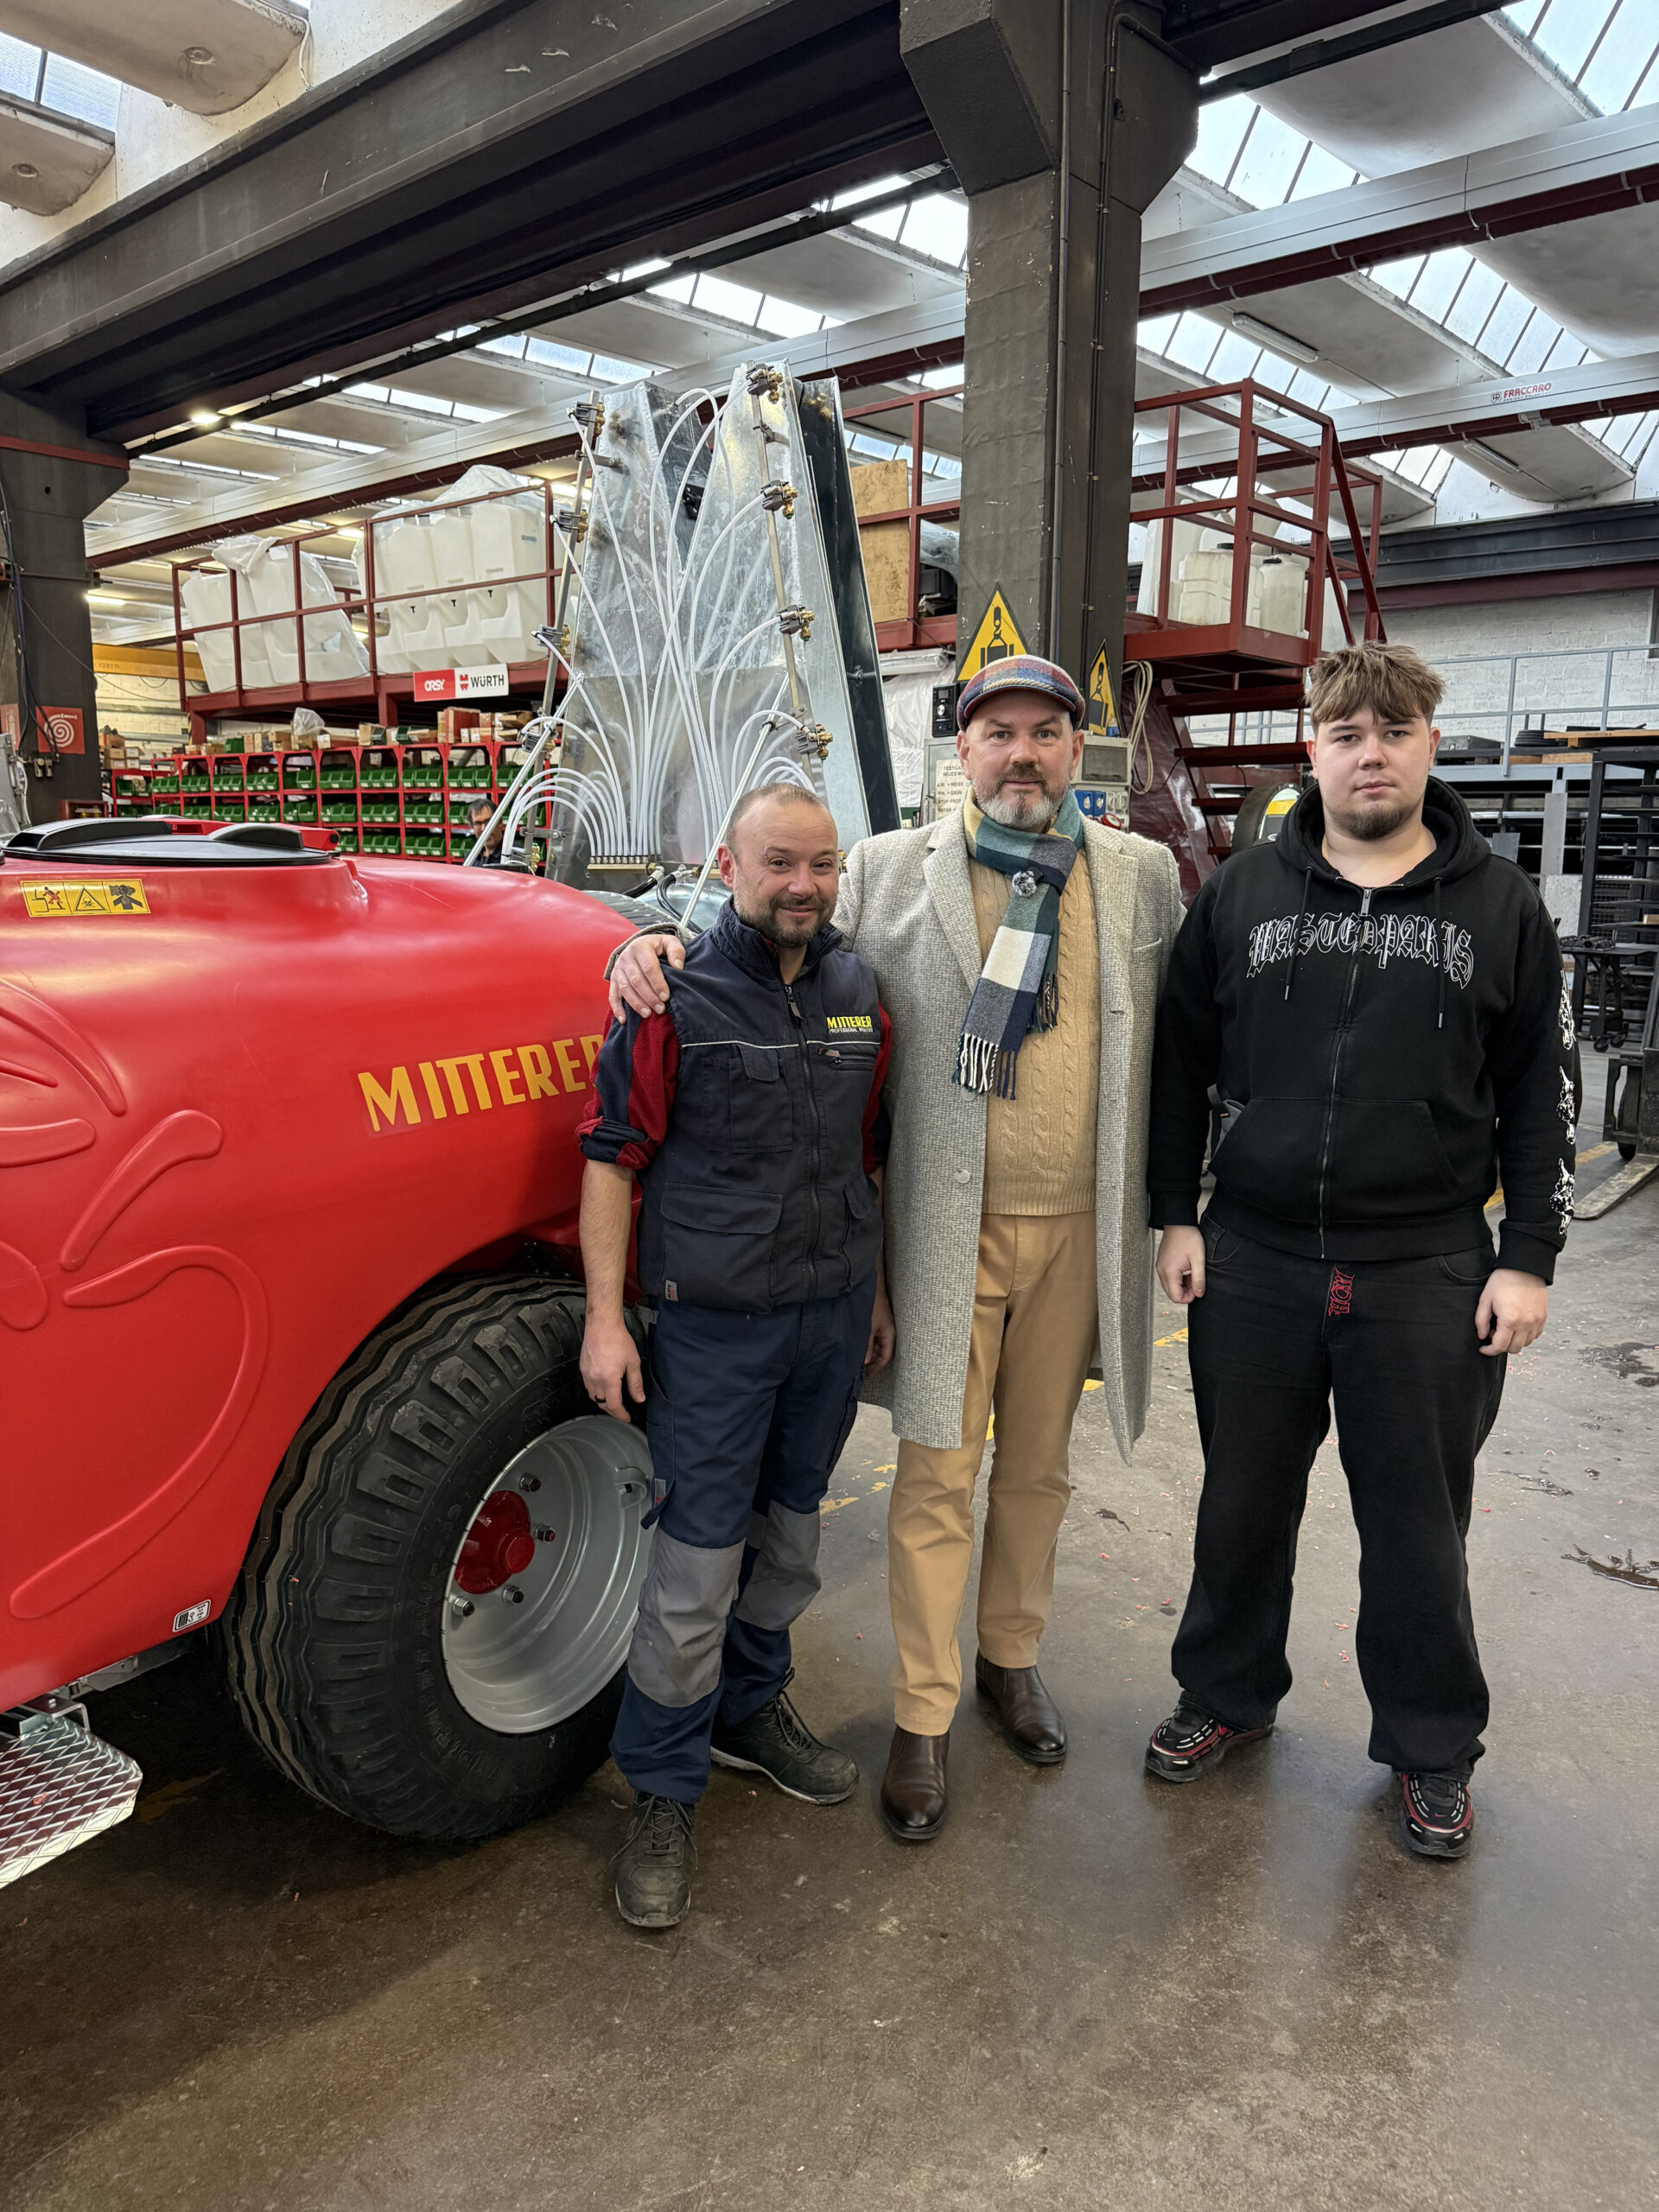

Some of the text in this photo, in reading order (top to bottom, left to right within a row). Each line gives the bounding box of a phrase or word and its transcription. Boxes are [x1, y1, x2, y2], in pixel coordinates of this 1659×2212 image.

[1503, 383, 1551, 398] FRACCARO
[470, 674, 505, 688] WÜRTH
[827, 1016, 872, 1028] MITTERER
